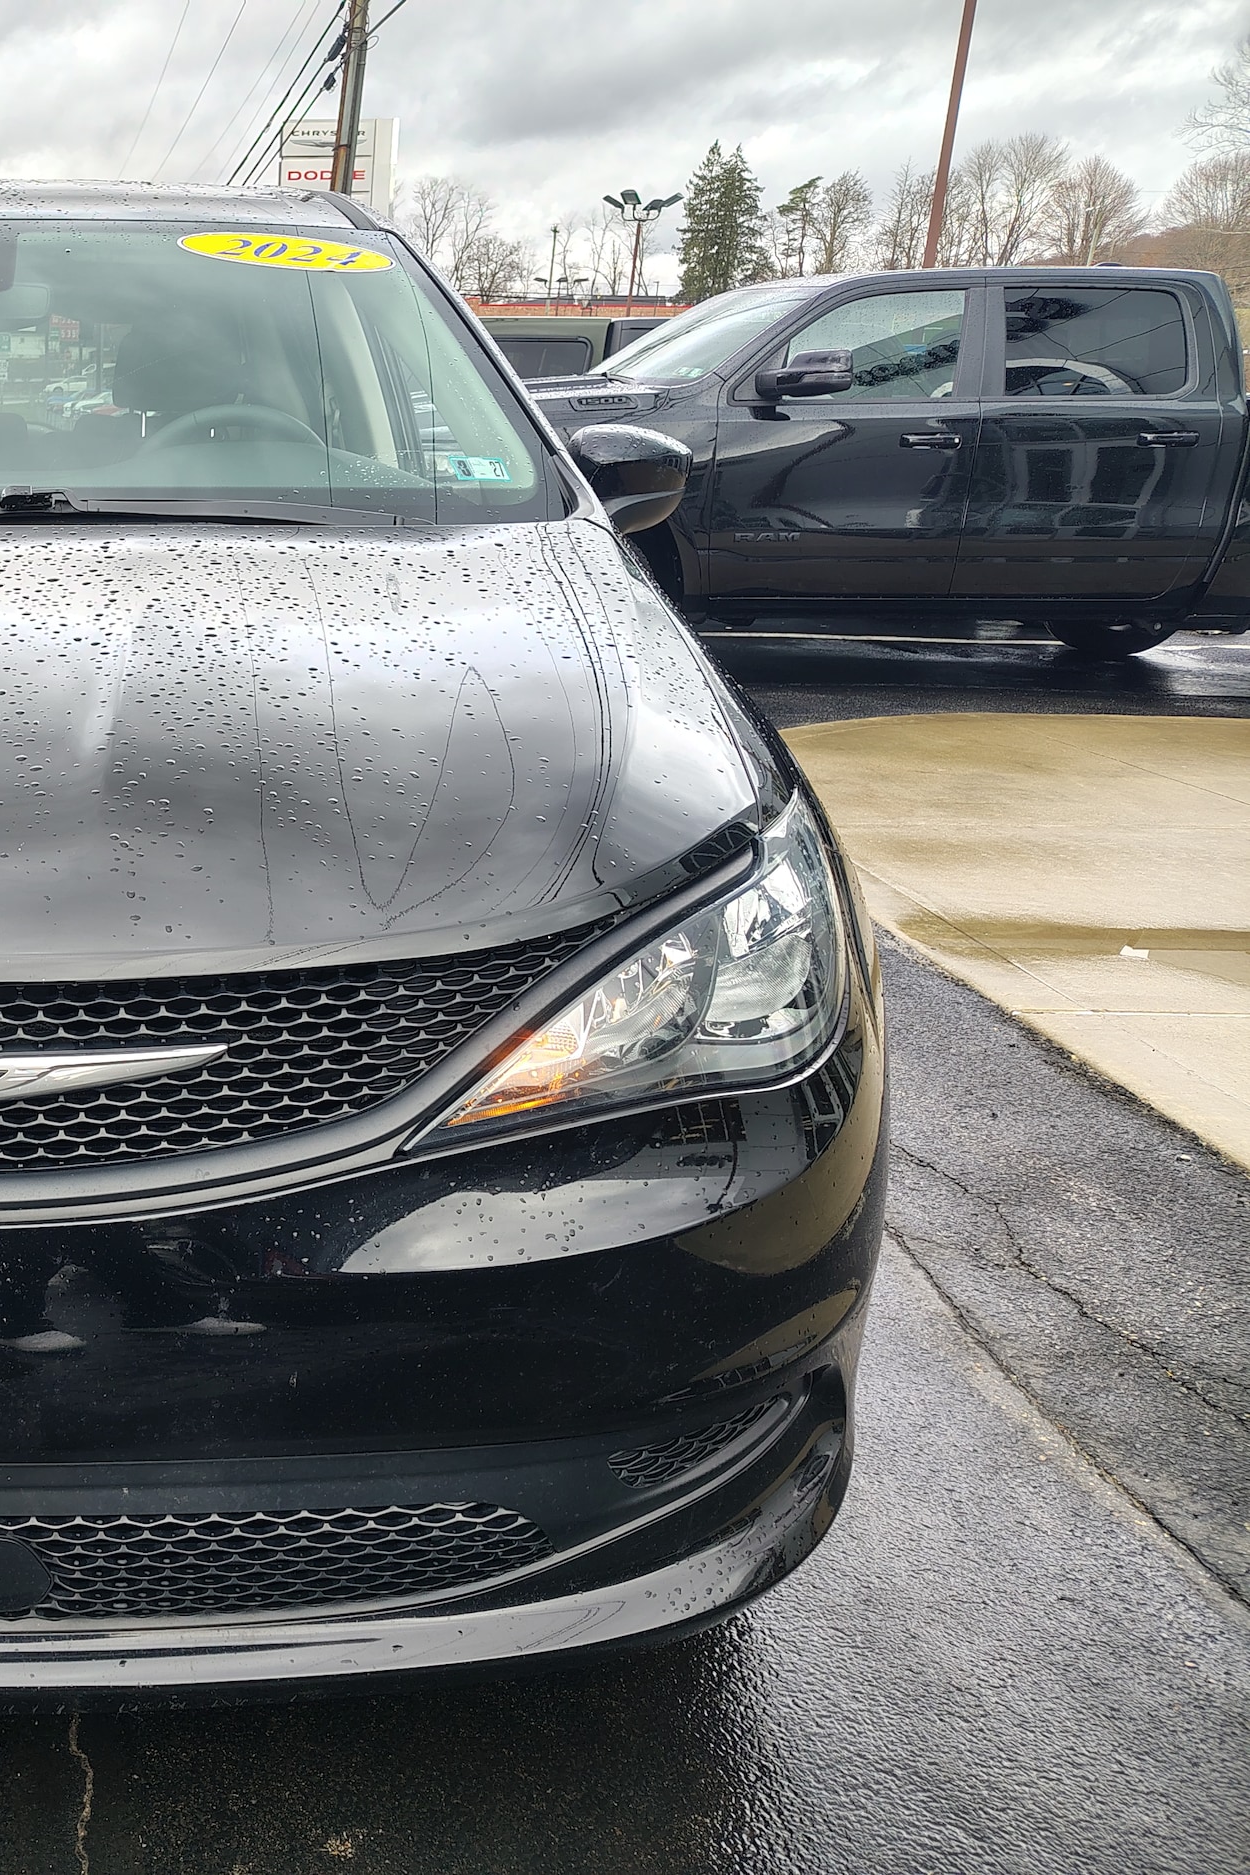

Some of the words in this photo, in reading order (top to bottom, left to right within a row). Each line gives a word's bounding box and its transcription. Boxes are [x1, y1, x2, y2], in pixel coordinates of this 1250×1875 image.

[287, 170, 366, 180] DODE
[217, 239, 364, 266] 2024
[580, 395, 628, 406] 1500
[488, 461, 505, 478] 27
[734, 532, 801, 543] RAM
